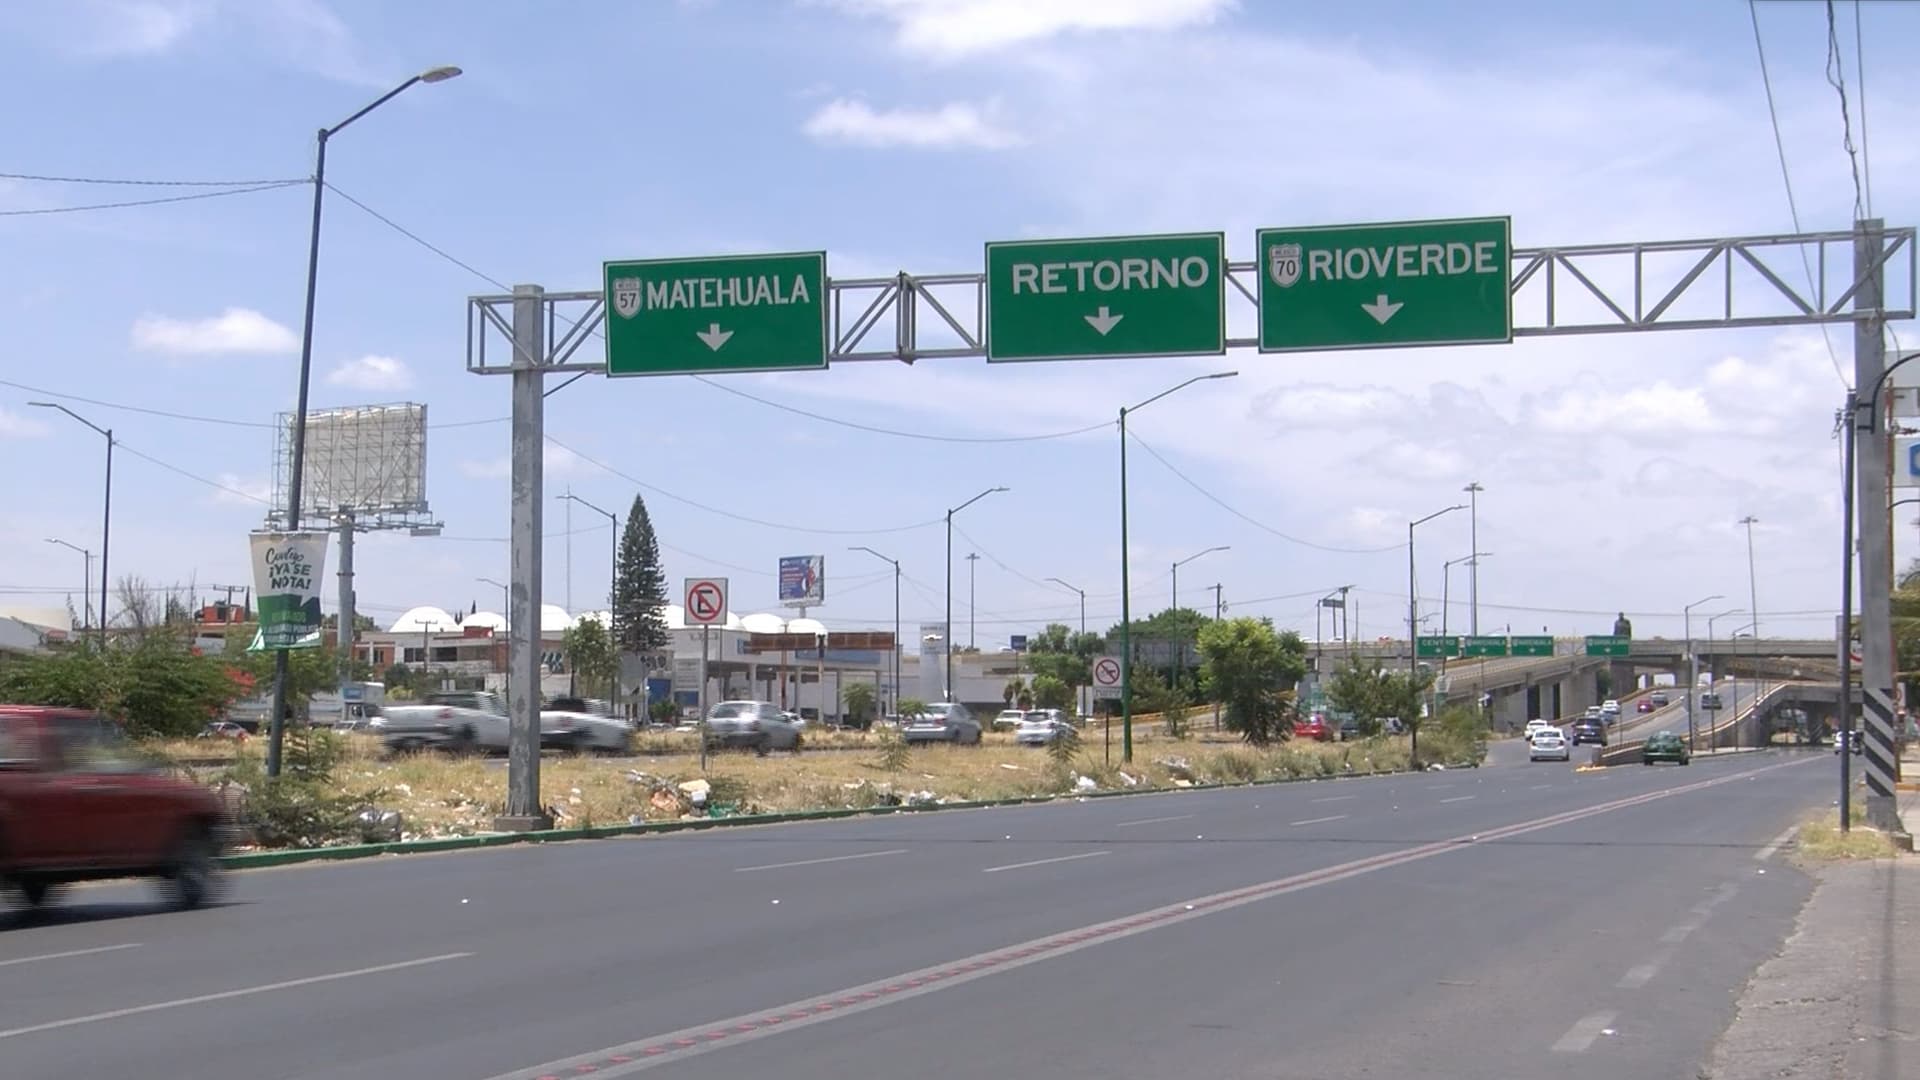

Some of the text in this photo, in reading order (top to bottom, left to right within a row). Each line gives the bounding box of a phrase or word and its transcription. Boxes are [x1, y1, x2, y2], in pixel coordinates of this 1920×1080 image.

[1012, 256, 1209, 295] RETORNO
[1276, 241, 1498, 281] 70 RIOVERDE
[620, 274, 811, 310] 57 MATEHUALA
[272, 576, 312, 589] NOTA!
[293, 564, 312, 576] SE
